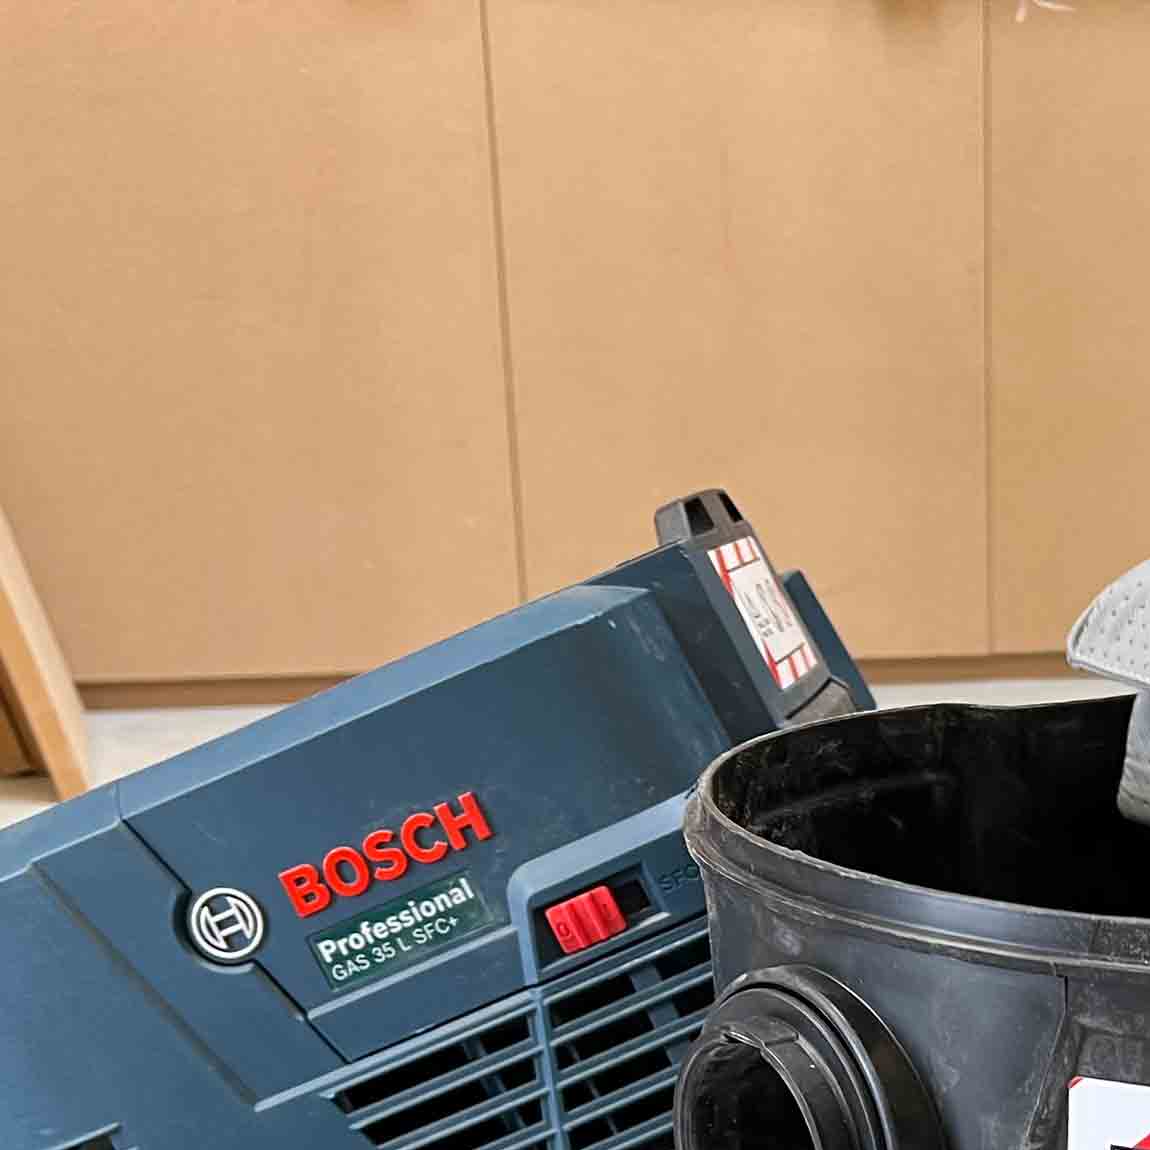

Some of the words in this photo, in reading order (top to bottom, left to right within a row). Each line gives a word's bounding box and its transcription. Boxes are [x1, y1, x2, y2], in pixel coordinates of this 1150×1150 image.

[278, 792, 492, 918] BOSCH
[317, 877, 475, 963] Professional
[331, 953, 371, 981] GAS
[371, 941, 397, 963] 35
[398, 937, 412, 952] L
[412, 916, 460, 945] SFC+
